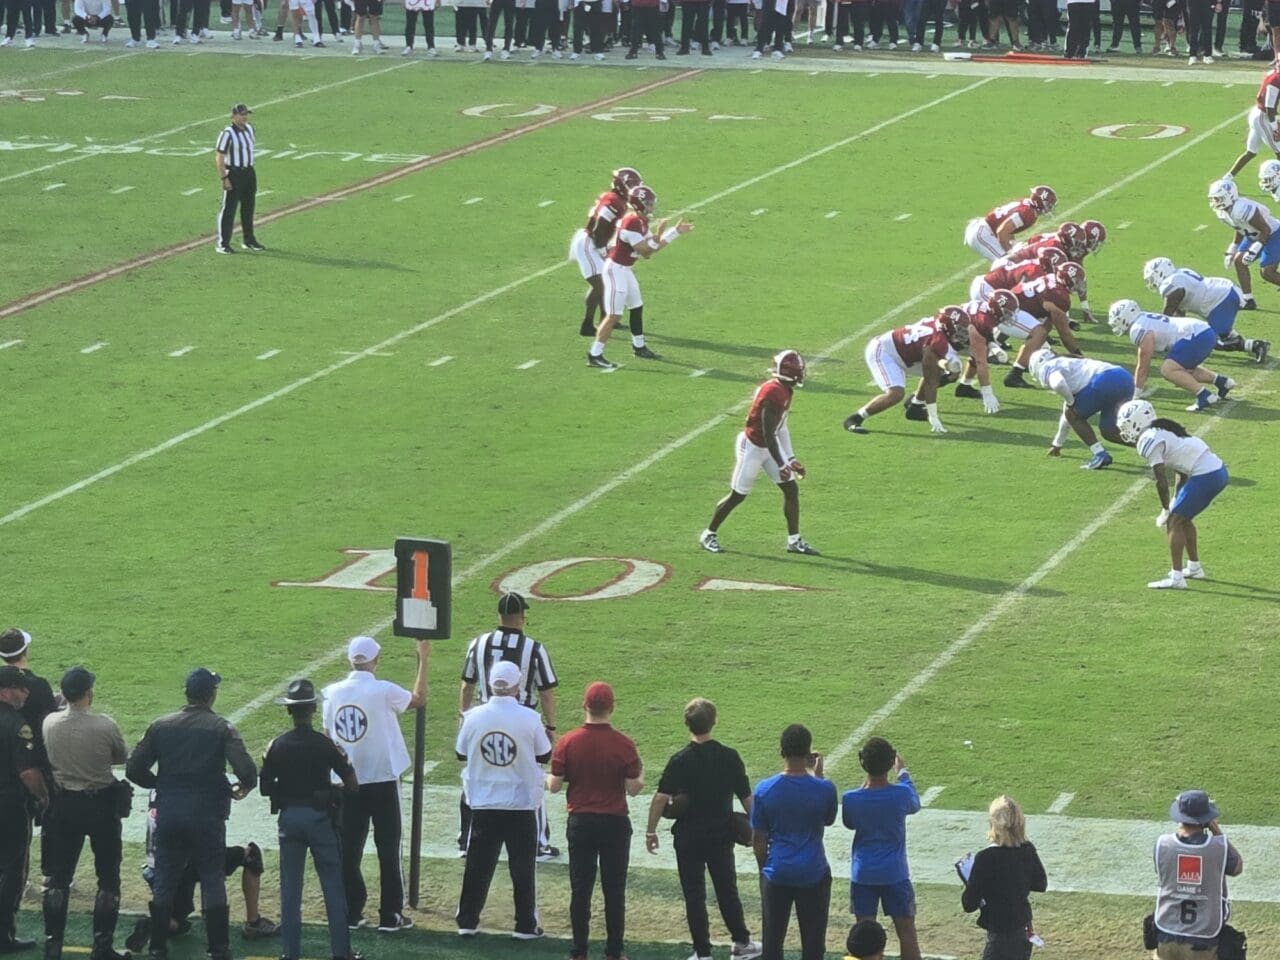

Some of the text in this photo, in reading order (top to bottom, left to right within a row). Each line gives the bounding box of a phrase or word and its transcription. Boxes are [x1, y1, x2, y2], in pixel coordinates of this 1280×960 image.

[410, 550, 431, 602] 1
[335, 707, 367, 742] SEC
[482, 733, 517, 766] SEC
[1180, 900, 1198, 925] 6
